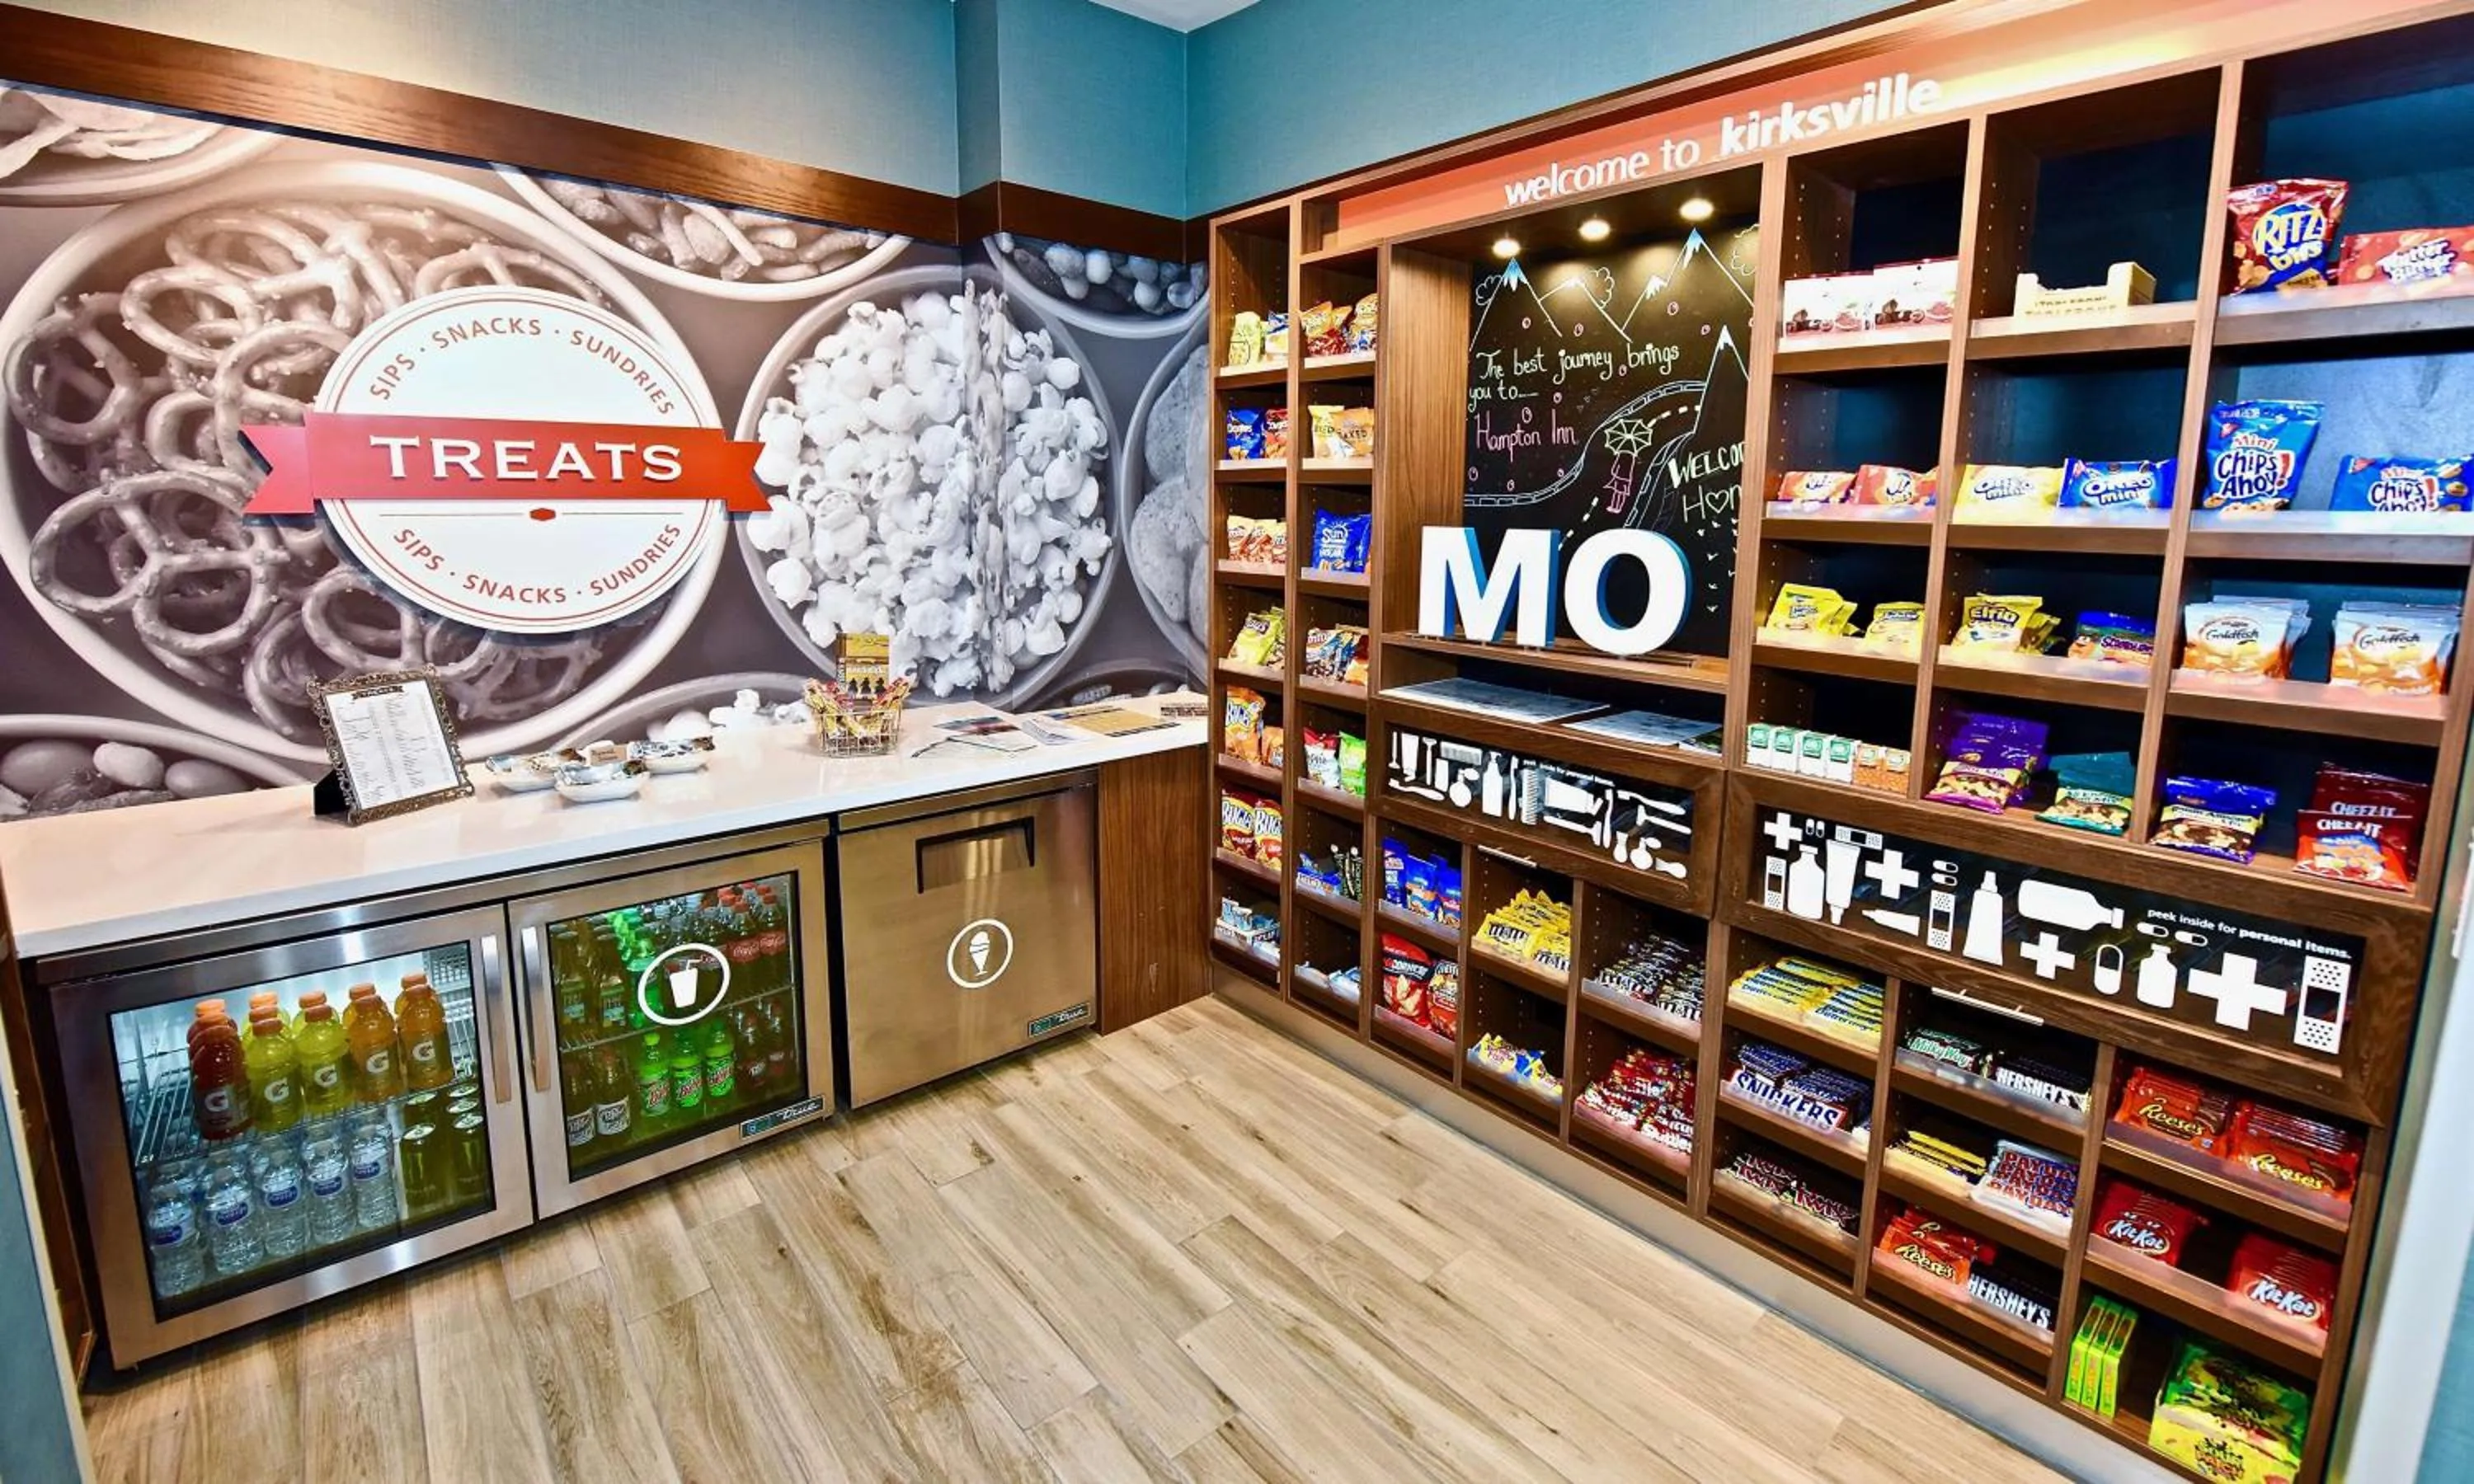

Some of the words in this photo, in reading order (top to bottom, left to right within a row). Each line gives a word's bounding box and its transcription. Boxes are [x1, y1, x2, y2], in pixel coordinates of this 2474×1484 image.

[1503, 149, 1649, 207] welcome
[1660, 139, 1700, 172] to
[1719, 73, 1943, 157] kirksville
[2263, 209, 2325, 250] RITZ
[369, 352, 416, 402] SIPS
[431, 317, 543, 350] SNACKS
[570, 330, 675, 416] SUNDRIES
[1475, 350, 1504, 380] The
[1513, 346, 1547, 376] best
[1553, 348, 1613, 386] journey
[1627, 343, 1681, 376] brings
[1467, 385, 1492, 412] you
[369, 434, 684, 482] TREATS
[1475, 411, 1541, 463] Hampton
[1551, 409, 1578, 445] Inn
[2216, 452, 2279, 479] Chips
[2368, 481, 2424, 505] Chips
[1321, 526, 1348, 544] Sun
[393, 528, 444, 572] SIPS
[462, 573, 567, 604] SNACKS
[590, 524, 681, 596] SUNDRIES
[1418, 526, 1694, 656] MO
[2205, 627, 2260, 641] Goldfish
[2359, 632, 2421, 649] Goldfish
[2147, 909, 2176, 923] peek
[2179, 913, 2215, 932] inside
[2217, 921, 2237, 935] for
[2239, 928, 2302, 949] personal
[2305, 942, 2353, 960] items.
[1736, 1071, 1839, 1127] SNICKERS
[1967, 1273, 2051, 1330] HERSHEY'S
